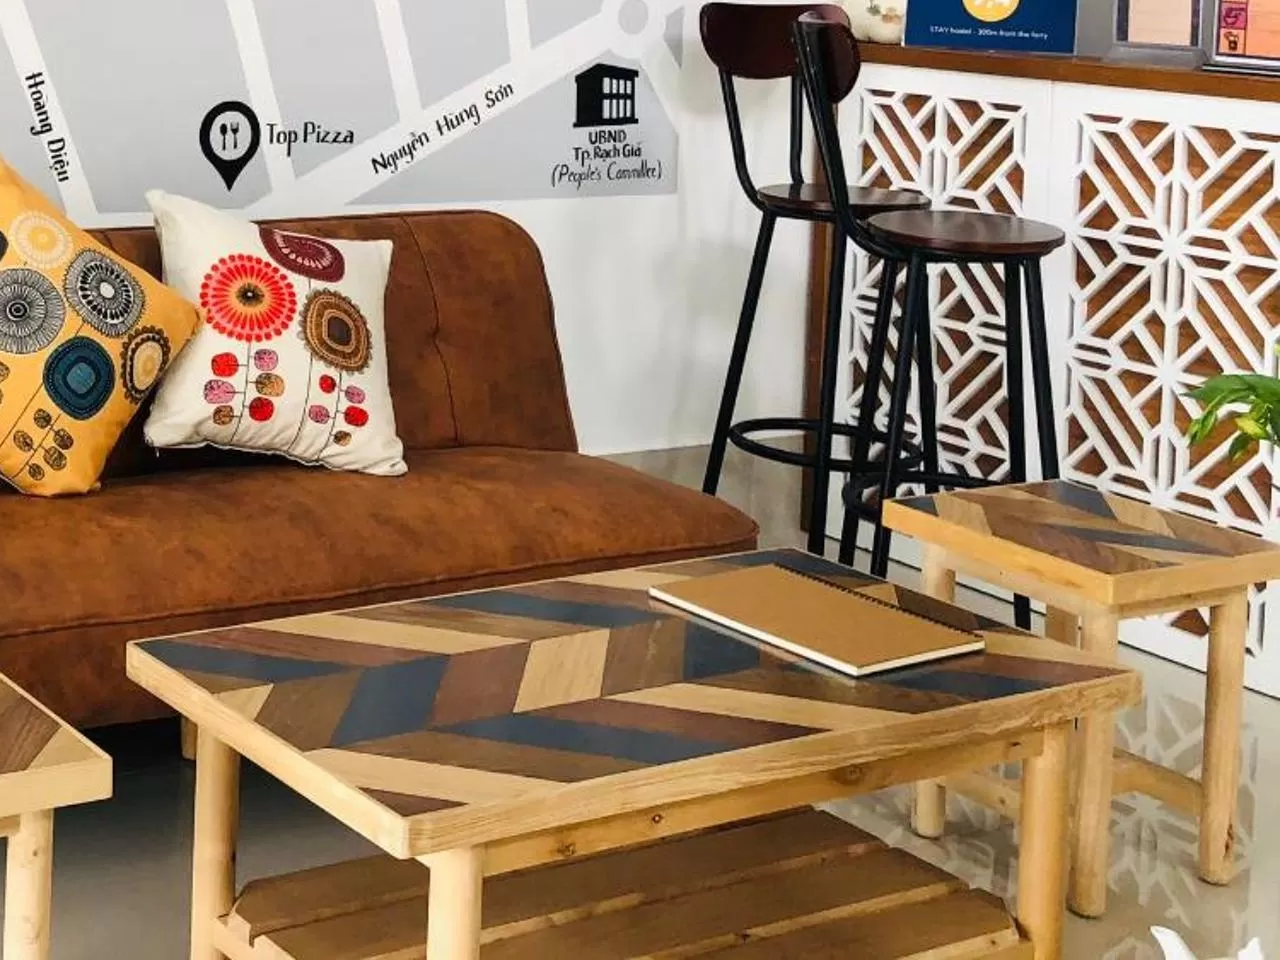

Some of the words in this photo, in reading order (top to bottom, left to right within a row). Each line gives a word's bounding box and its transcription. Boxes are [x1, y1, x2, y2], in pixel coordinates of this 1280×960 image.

[25, 72, 53, 136] Hoàng
[48, 137, 70, 182] Diệu
[266, 123, 298, 157] Top
[303, 122, 354, 145] Pizza
[371, 131, 430, 174] Nguyễn
[436, 104, 480, 136] Hùng
[484, 83, 514, 108] Sơn
[588, 130, 627, 145] UBND
